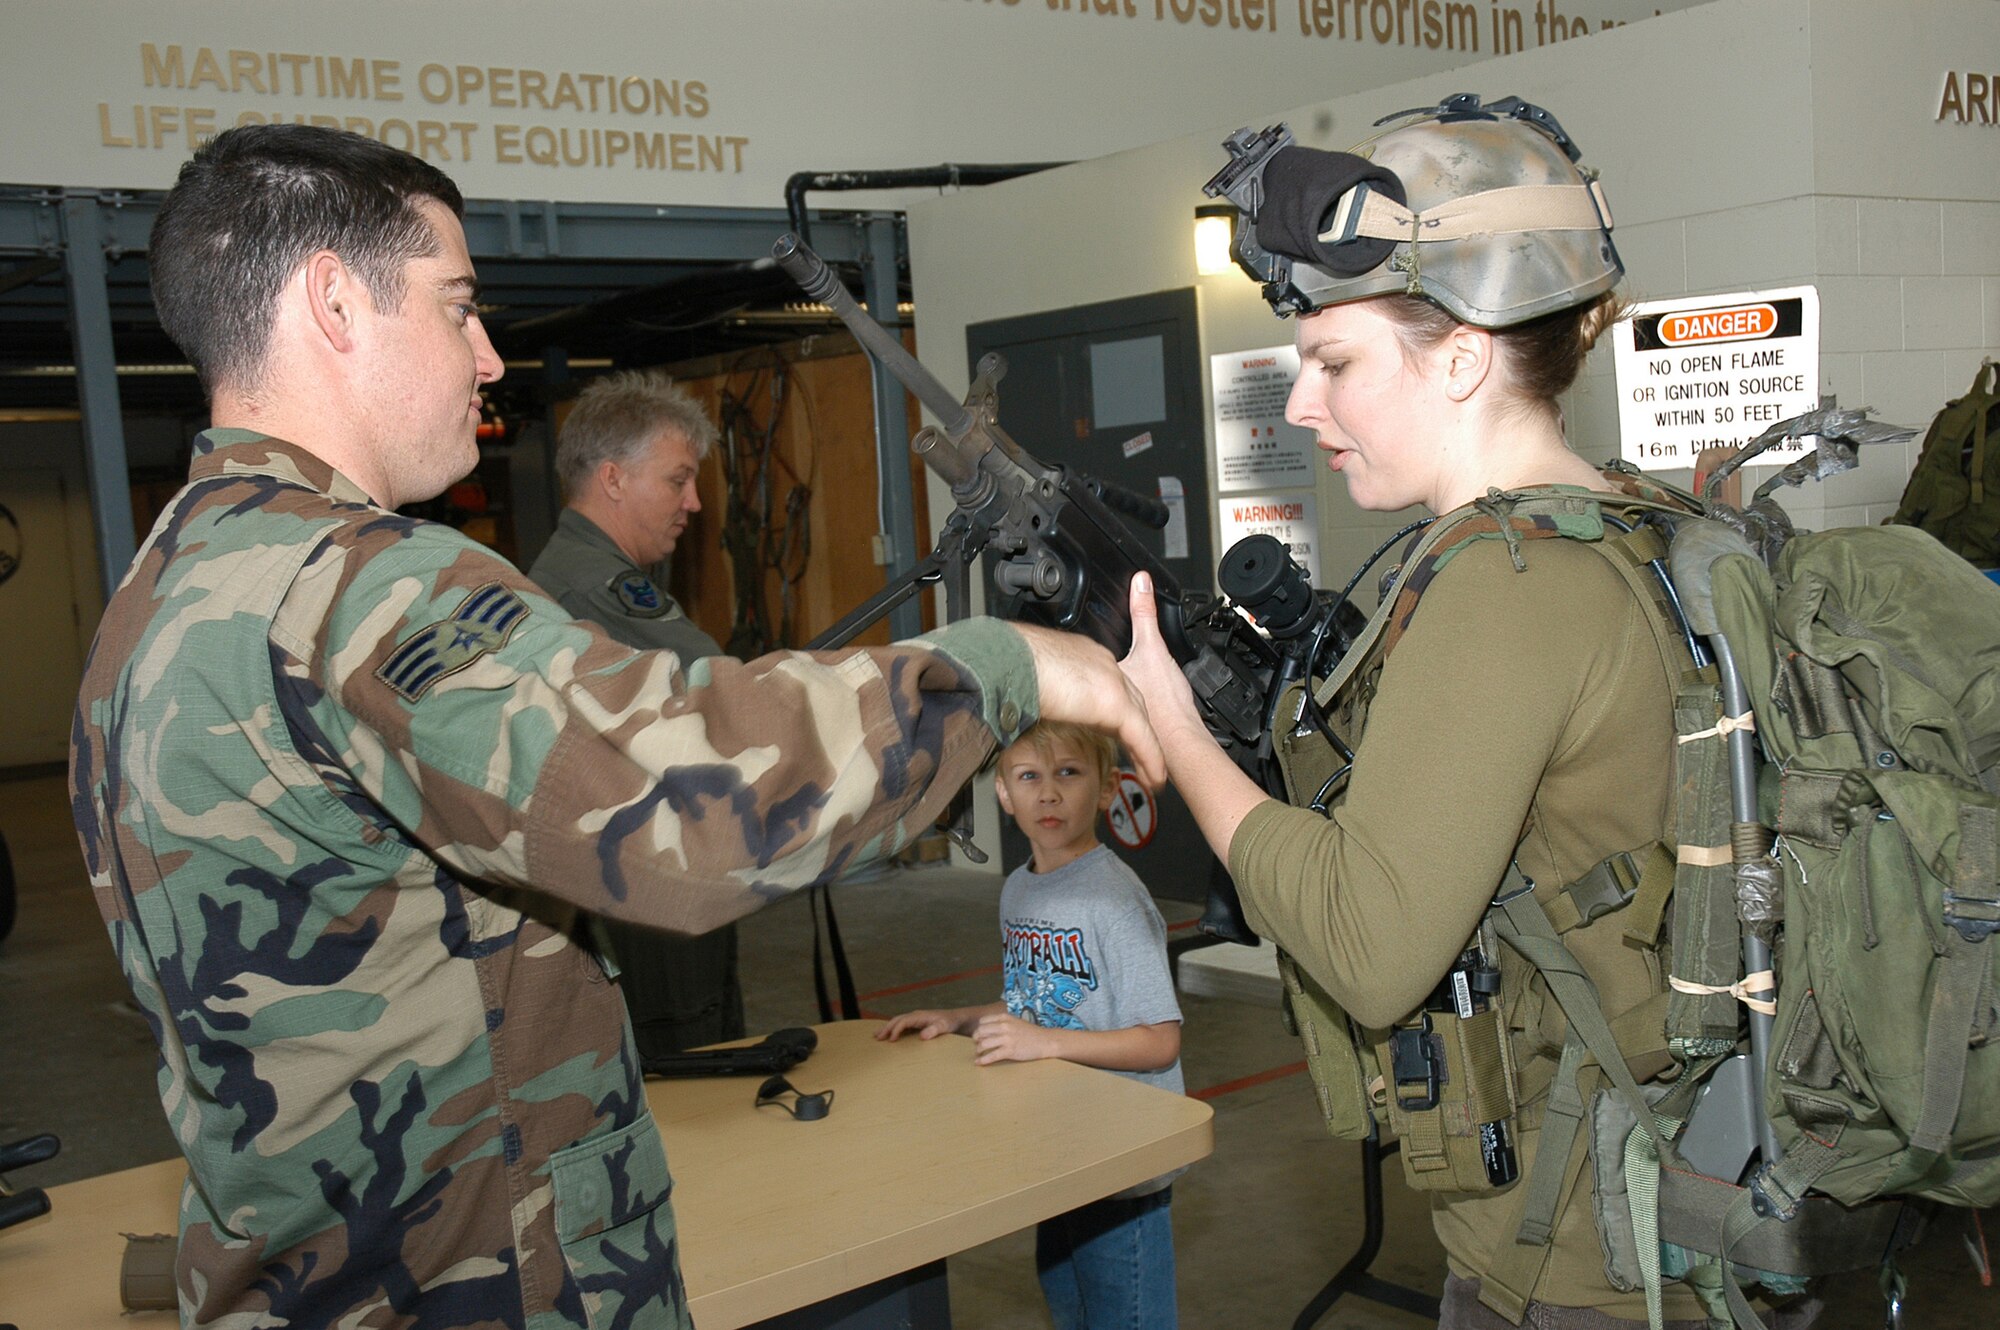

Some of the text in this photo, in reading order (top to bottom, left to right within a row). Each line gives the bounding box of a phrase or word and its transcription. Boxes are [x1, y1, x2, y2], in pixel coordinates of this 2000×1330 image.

[1492, 0, 1524, 54] in
[140, 42, 710, 118] MARITIME OPERATIONS
[98, 103, 216, 150] LIFE
[494, 124, 749, 173] EQUIPMENT
[1674, 310, 1762, 340] DANGER
[1242, 357, 1277, 369] WARNING
[1650, 349, 1784, 376] NO OPEN FLAME
[1633, 375, 1804, 403] OR IGNITION SOURCE
[1654, 404, 1783, 427] WITHIN 50 FEET
[1638, 442, 1677, 458] 16m
[1233, 503, 1304, 523] WARNING!!!
